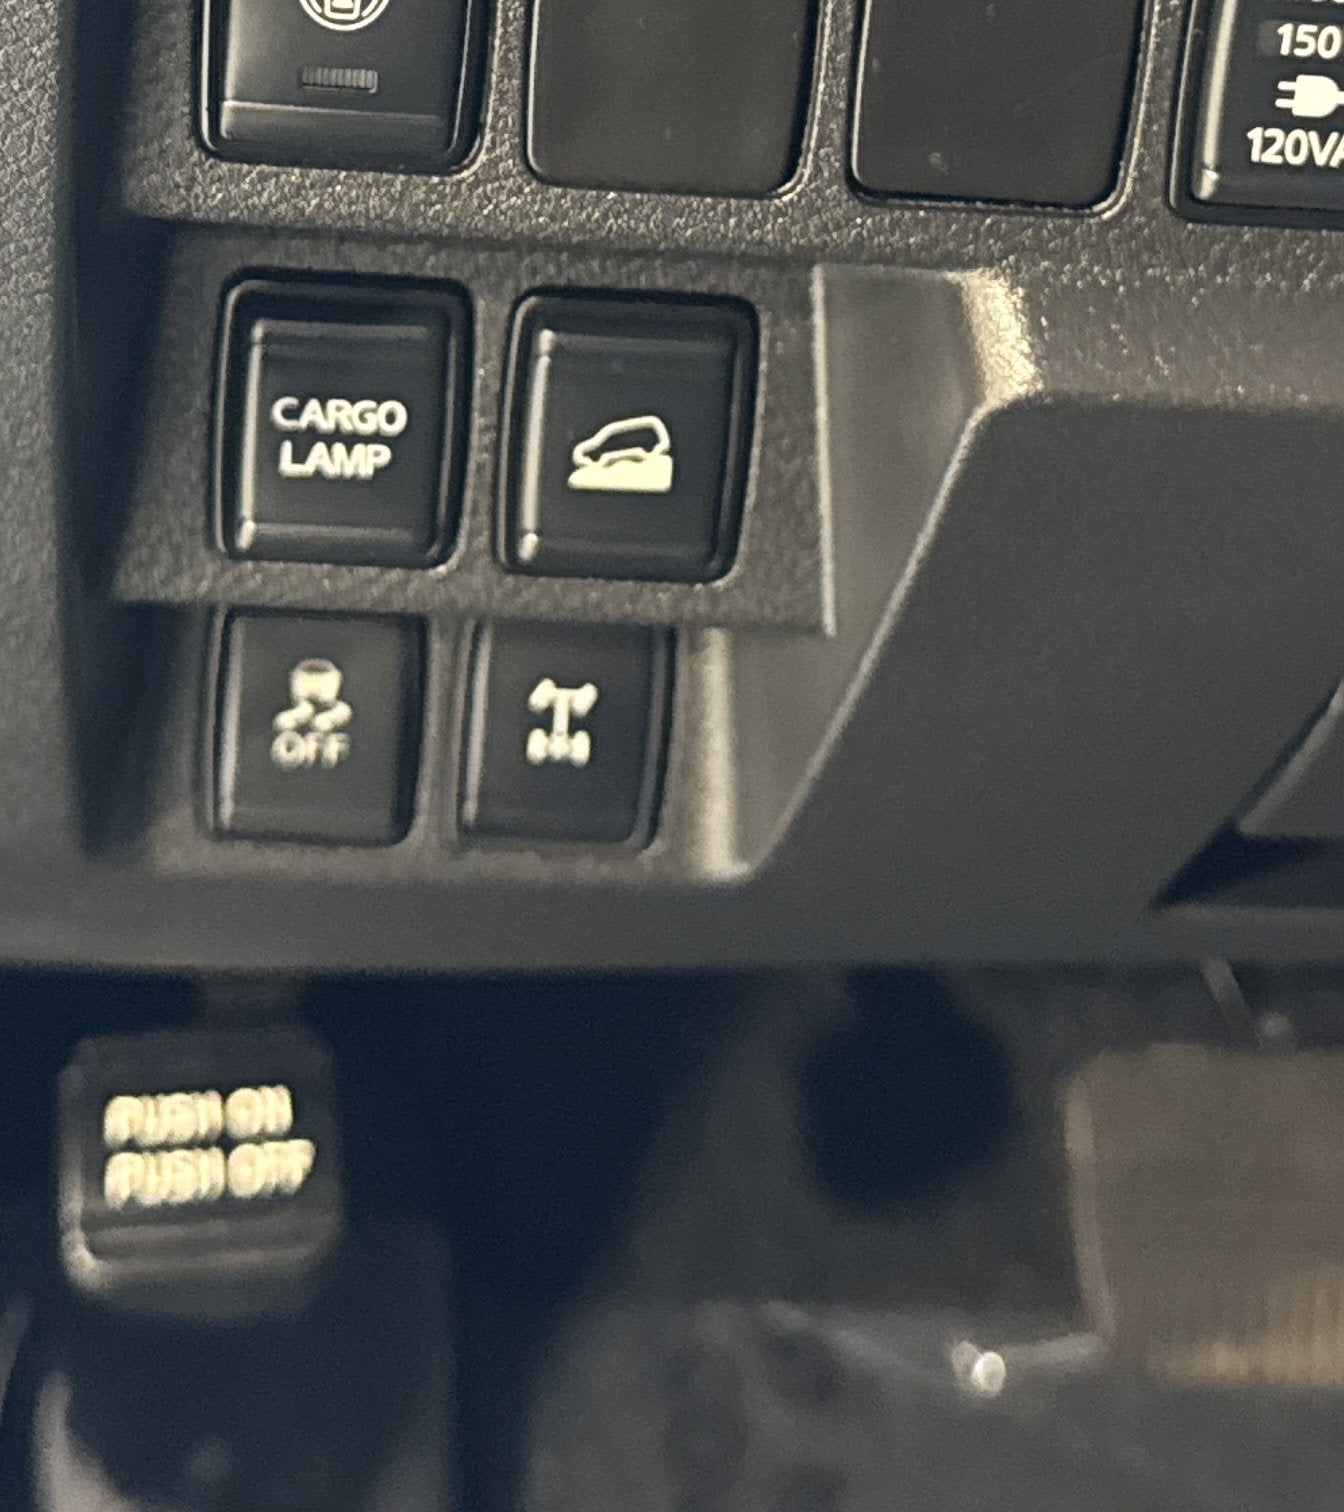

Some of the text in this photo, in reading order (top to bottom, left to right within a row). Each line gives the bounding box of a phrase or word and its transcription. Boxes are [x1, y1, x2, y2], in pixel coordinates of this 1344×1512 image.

[271, 396, 408, 436] CARGO
[278, 440, 392, 479] LAMP
[271, 731, 349, 769] OFF
[104, 1085, 293, 1148] PUSH ON
[104, 1139, 316, 1210] PUSH OFF
